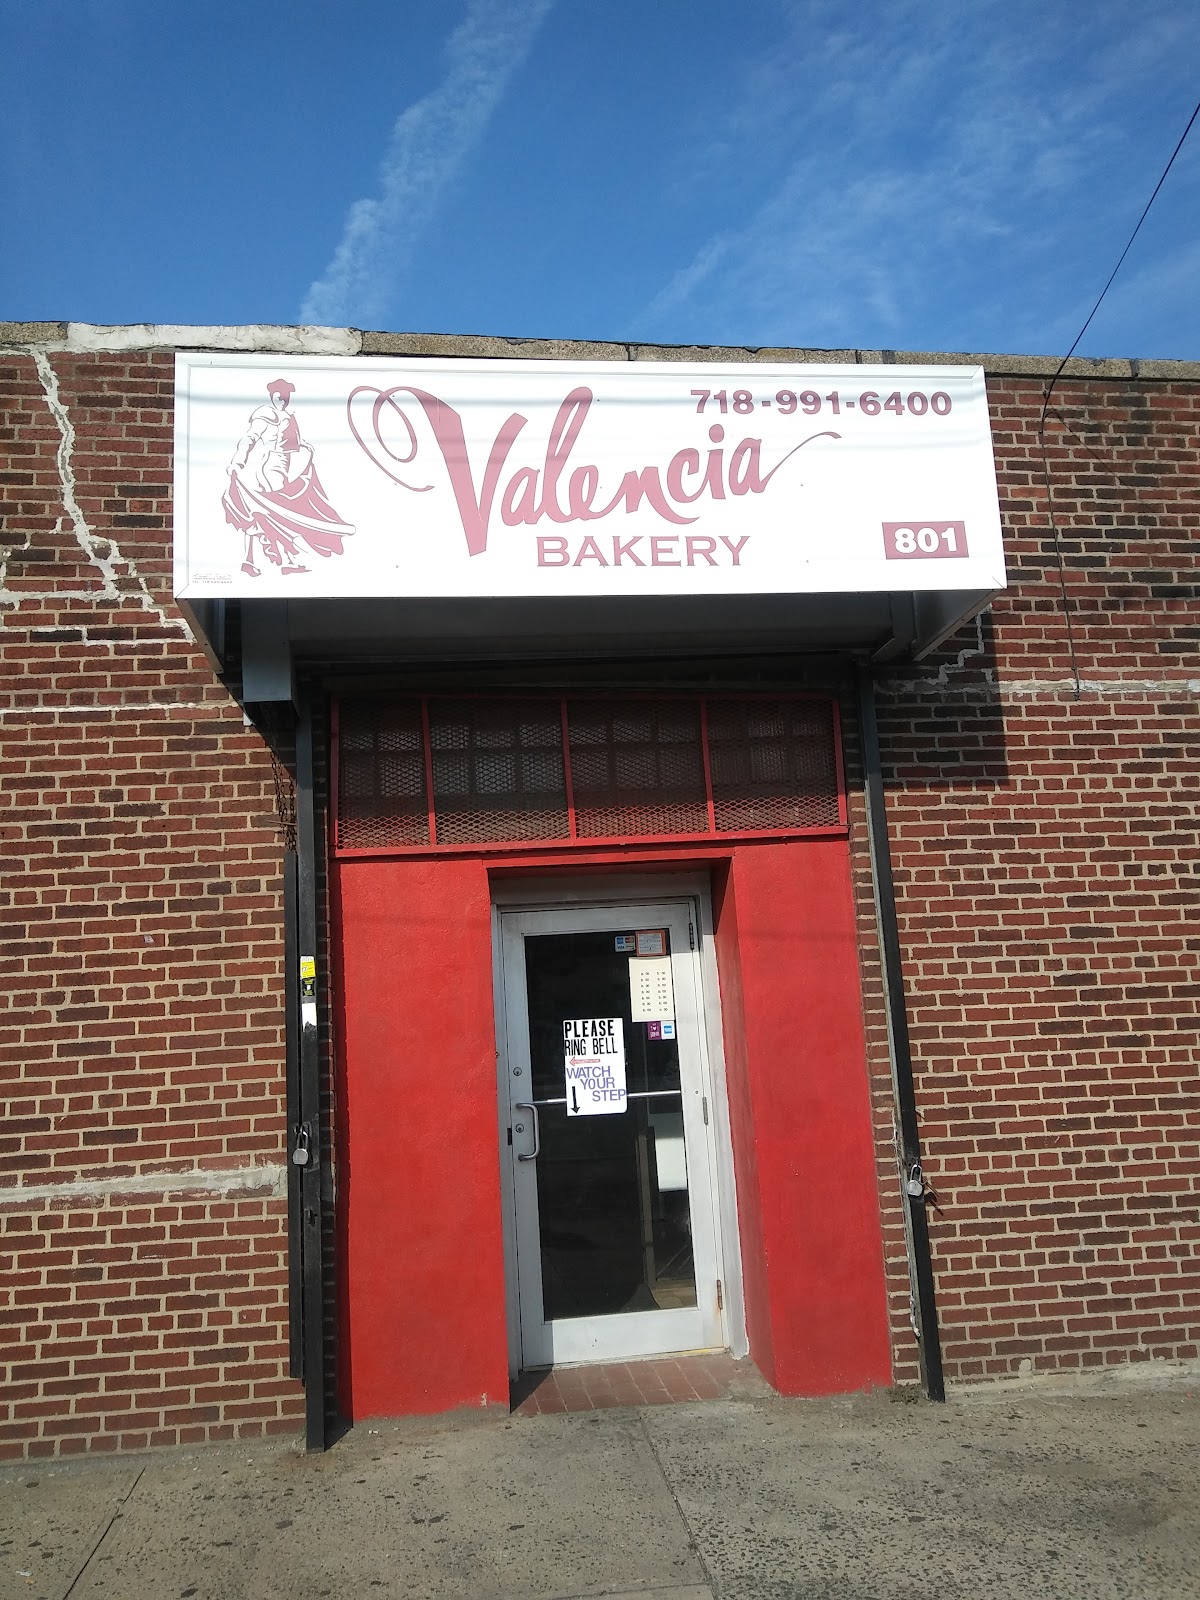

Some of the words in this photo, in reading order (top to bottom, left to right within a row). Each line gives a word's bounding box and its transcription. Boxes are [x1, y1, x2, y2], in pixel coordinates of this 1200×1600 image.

[690, 389, 953, 416] 718-991-6400
[347, 385, 842, 557] Valencia
[893, 526, 958, 554] 801
[536, 535, 751, 568] BAKERY
[564, 1019, 615, 1038] PLEASE
[564, 1038, 587, 1056] RING
[592, 1036, 618, 1055] BELL
[566, 1065, 611, 1079] WATCH
[580, 1077, 616, 1090] YOUR
[592, 1088, 627, 1102] STEP
